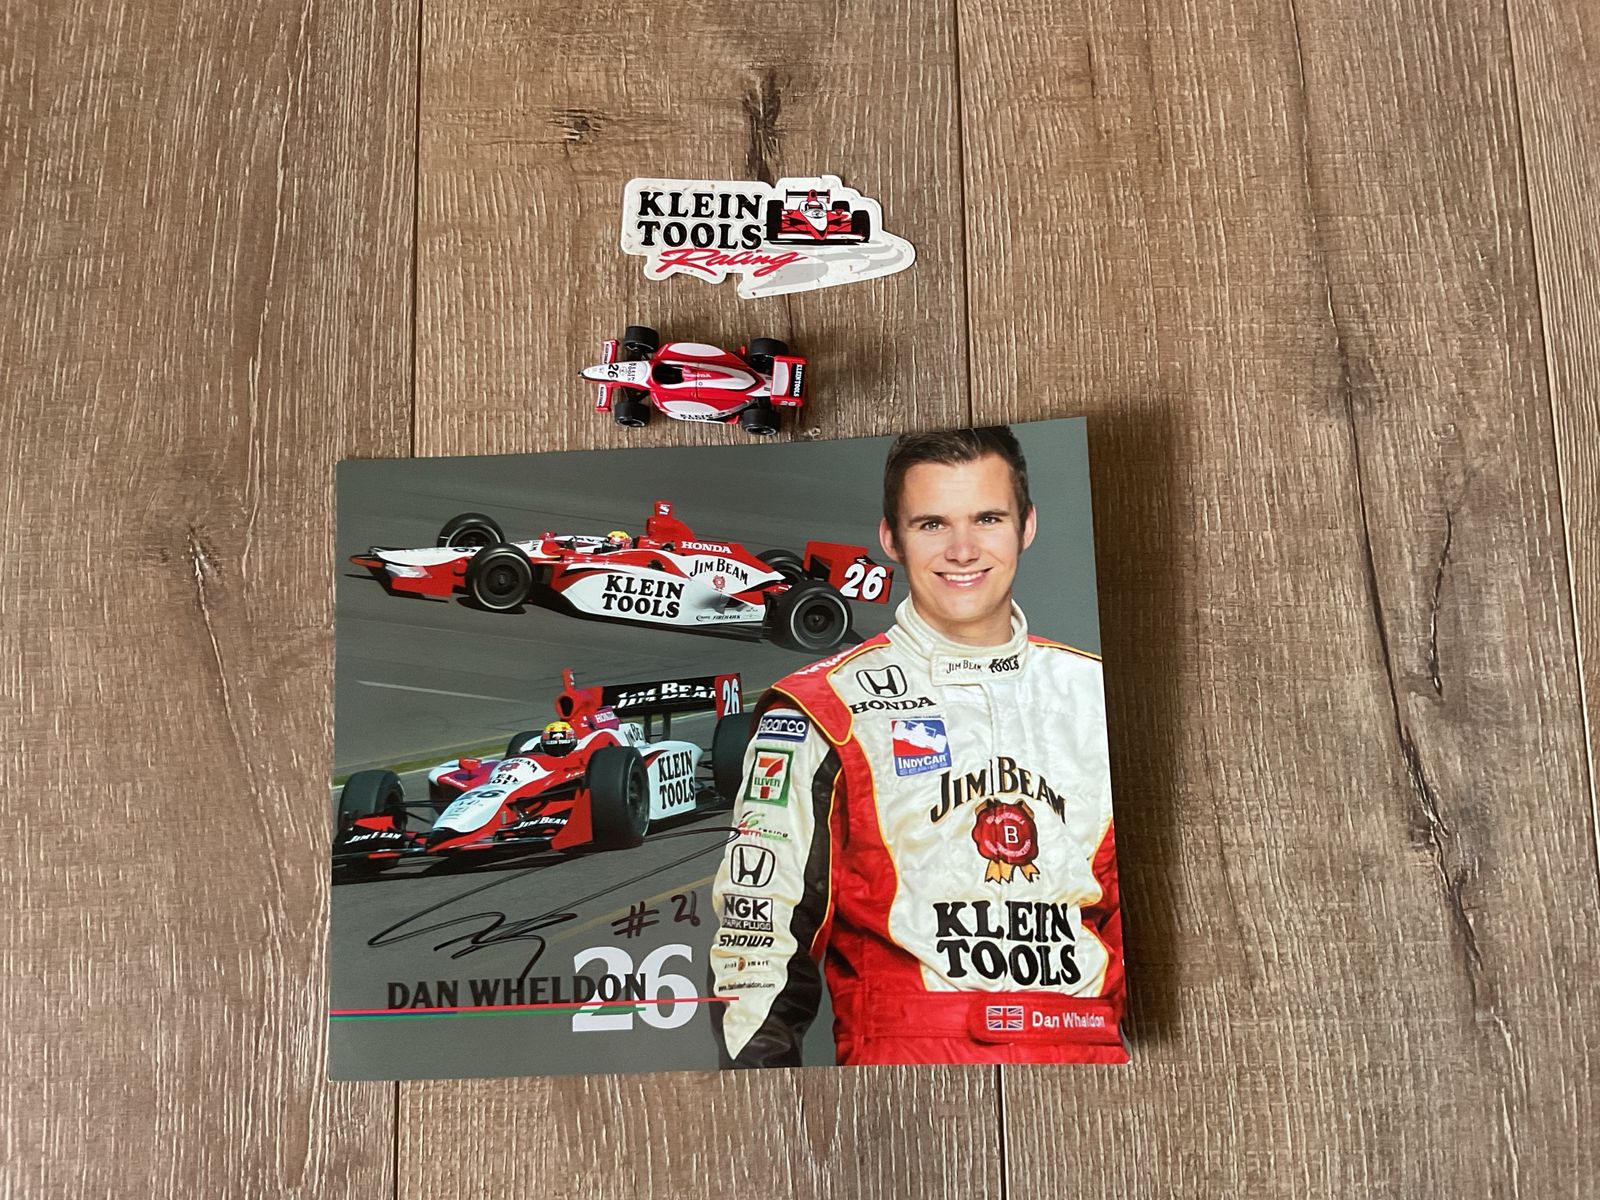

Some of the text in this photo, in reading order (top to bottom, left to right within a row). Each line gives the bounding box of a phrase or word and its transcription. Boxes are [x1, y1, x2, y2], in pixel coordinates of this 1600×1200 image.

[638, 191, 763, 220] KLEIN
[637, 221, 763, 250] TOOLS
[655, 248, 808, 278] Racing
[607, 364, 619, 379] 26
[681, 541, 732, 554] HONDA
[690, 558, 749, 586] JIM BEAM
[839, 563, 887, 600] 26
[604, 574, 685, 600] KLEIN
[602, 593, 681, 618] TOOLS
[612, 688, 657, 709] JIM
[722, 678, 740, 716] 26
[849, 696, 937, 714] HONDA
[657, 750, 693, 783] KLEIN
[659, 777, 695, 810] TOOLS
[930, 755, 1067, 825] JIM BEAM
[1004, 825, 1019, 844] B
[724, 896, 769, 921] NGK
[933, 900, 1076, 942] KLEIN
[719, 934, 775, 948] SHOWA
[936, 939, 1081, 987] TOOLS
[387, 973, 646, 1010] DAN WHELDON
[572, 943, 699, 1032] 26
[1032, 1011, 1060, 1028] Dan
